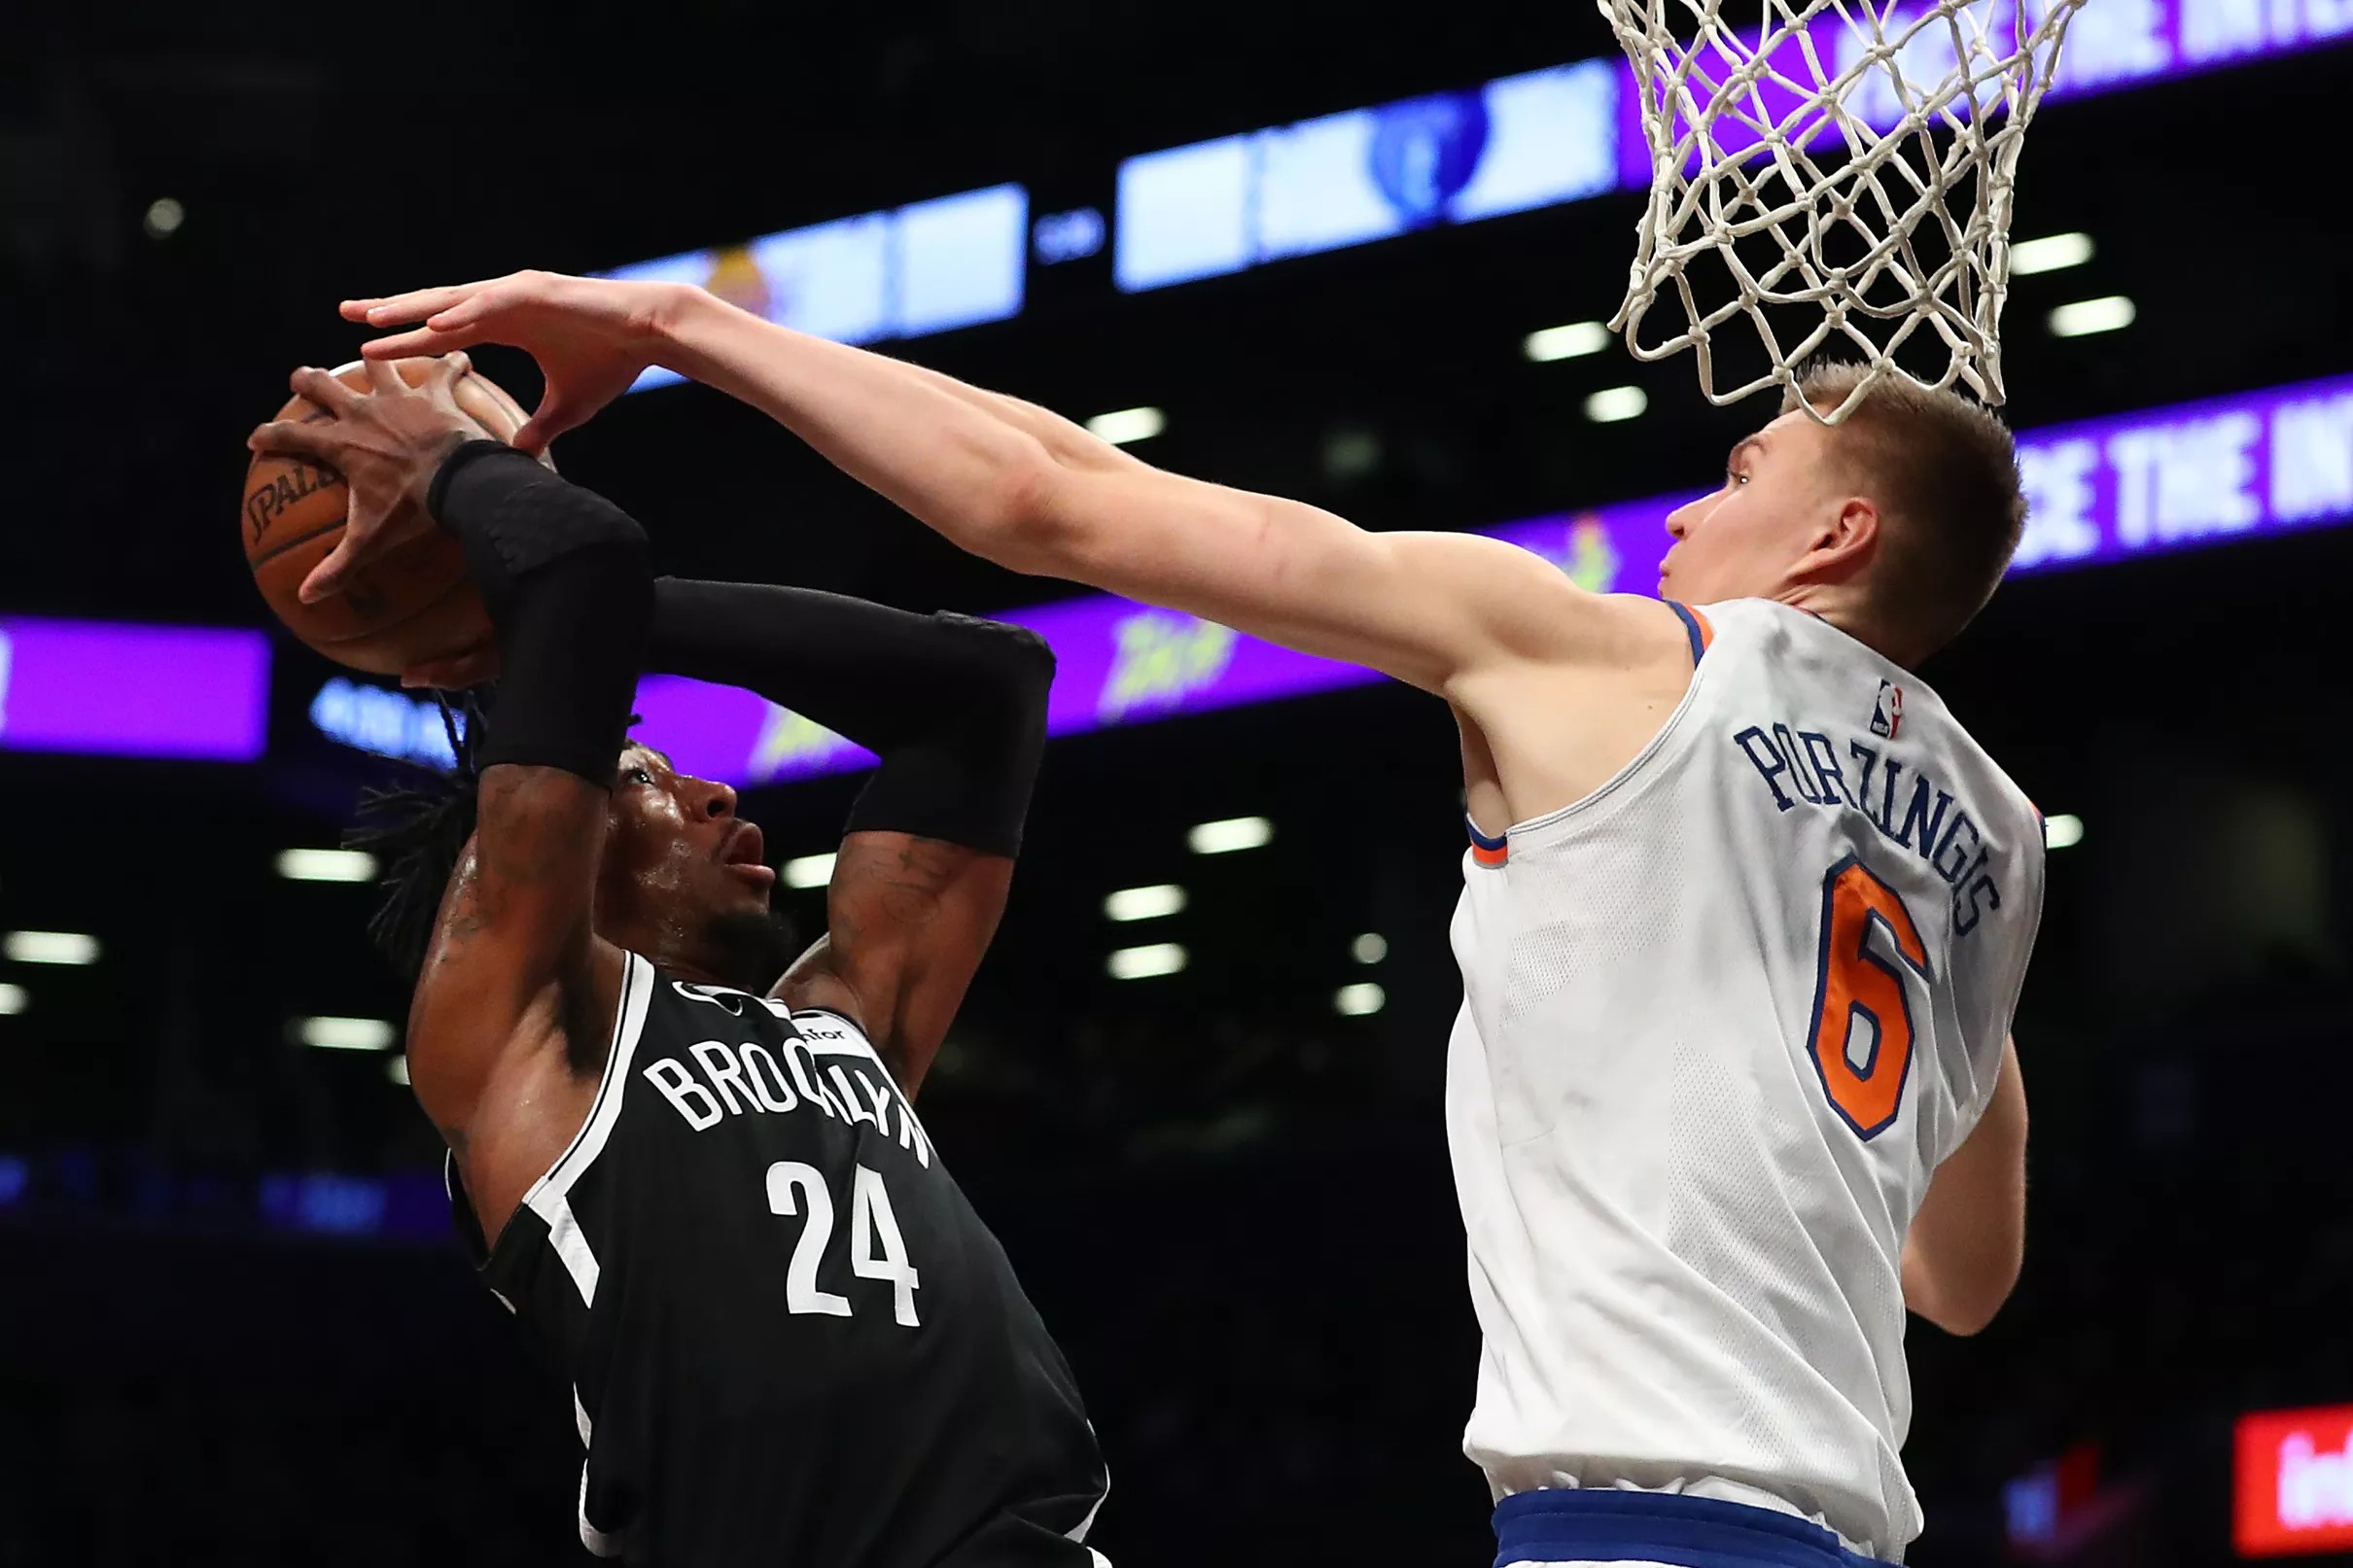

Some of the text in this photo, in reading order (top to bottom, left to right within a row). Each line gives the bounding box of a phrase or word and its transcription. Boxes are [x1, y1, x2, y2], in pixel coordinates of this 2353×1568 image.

[2108, 412, 2264, 549] THE
[1807, 853, 1931, 1142] 6
[643, 1037, 930, 1169] BROOKLYN
[765, 1161, 921, 1327] 24
